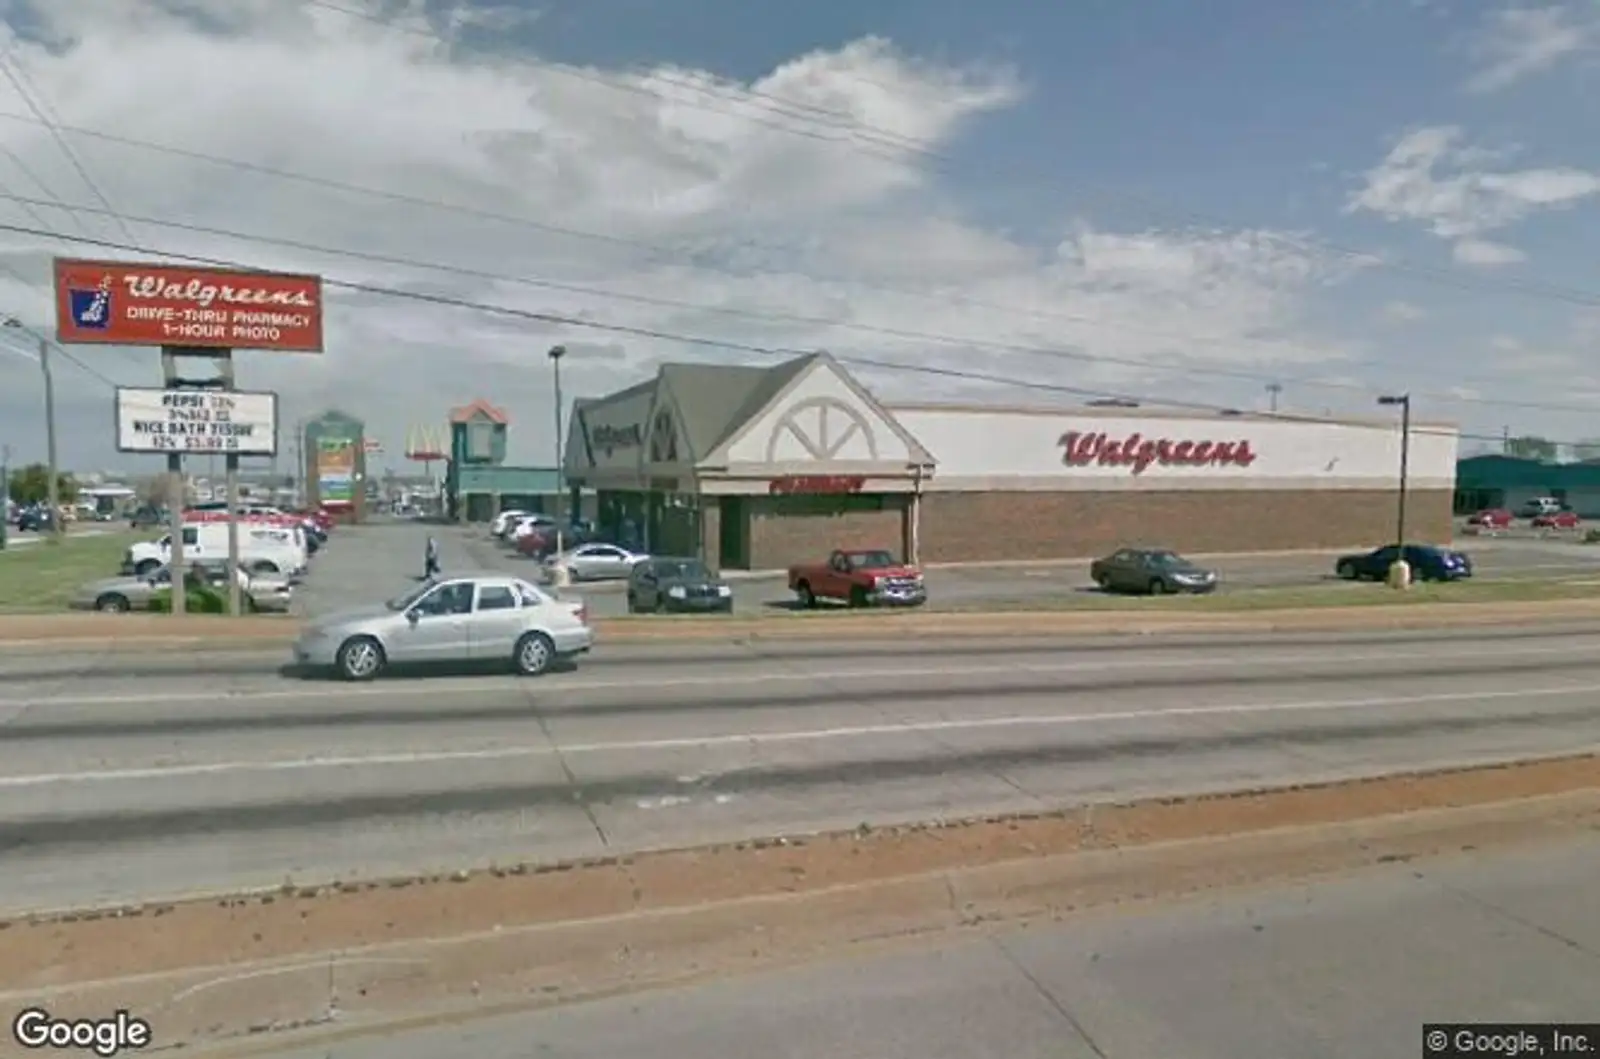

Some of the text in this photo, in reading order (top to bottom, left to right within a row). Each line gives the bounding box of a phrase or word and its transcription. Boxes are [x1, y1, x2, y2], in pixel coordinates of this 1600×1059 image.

[123, 275, 313, 306] Walgreens
[127, 306, 310, 328] DRIVE-THRU PHARMACY
[163, 323, 281, 340] 1-HOUR PHOTO
[162, 394, 204, 407] PEPSI
[1057, 430, 1256, 476] Walgreens
